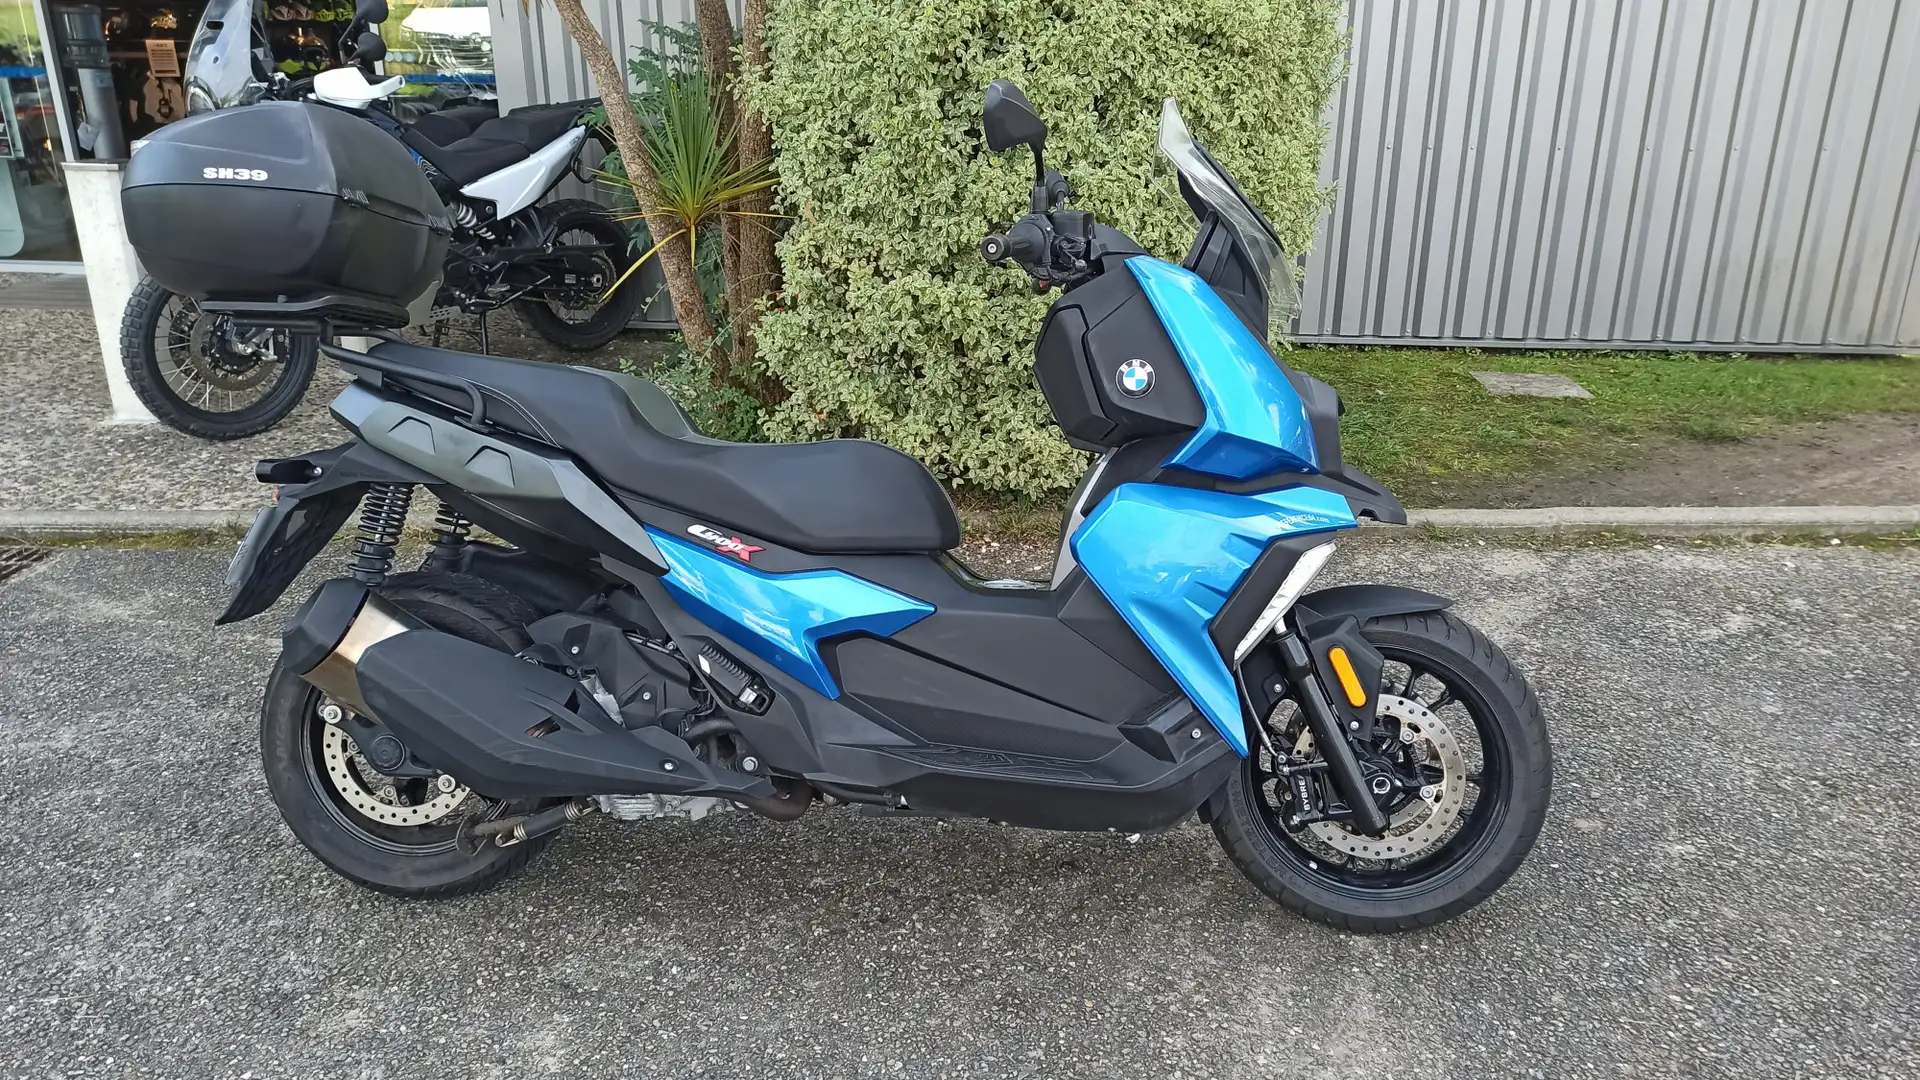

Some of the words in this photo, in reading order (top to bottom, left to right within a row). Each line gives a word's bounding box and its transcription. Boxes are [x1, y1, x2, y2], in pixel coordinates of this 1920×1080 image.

[203, 167, 268, 181] SH39
[1120, 360, 1153, 373] BMW
[1298, 779, 1311, 811] BYBRE
